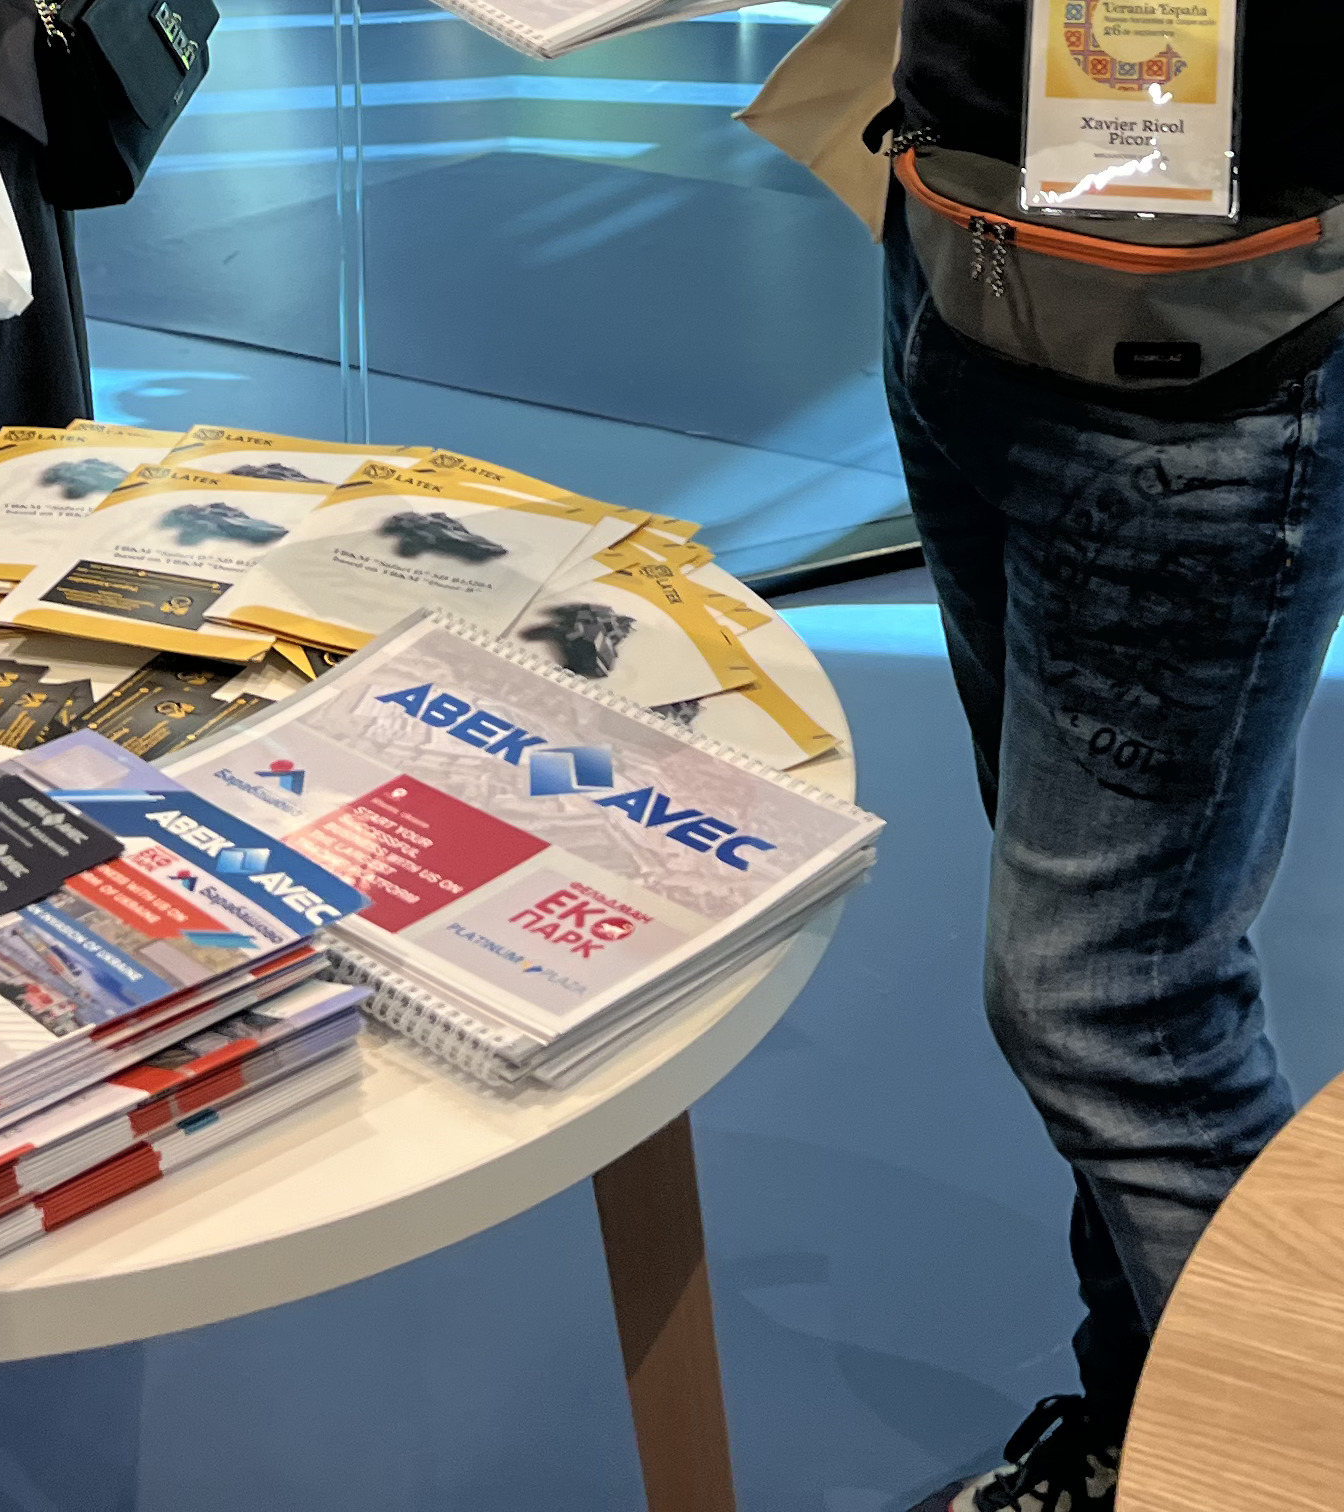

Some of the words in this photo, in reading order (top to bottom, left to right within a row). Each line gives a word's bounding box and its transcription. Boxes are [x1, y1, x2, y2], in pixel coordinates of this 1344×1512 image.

[1159, 3, 1207, 18] España
[1081, 116, 1136, 133] Xavier
[1143, 116, 1184, 134] Ricol
[225, 434, 273, 447] LATEK
[171, 472, 219, 486] LATEK
[459, 462, 505, 482] LATEK
[394, 474, 443, 493] LATEK
[353, 806, 398, 829] START
[395, 825, 433, 848] YOUR
[604, 786, 777, 871] AVEC
[419, 869, 442, 883] US
[439, 879, 464, 894] ON
[248, 871, 342, 927] AVEC
[446, 922, 524, 964] PLATINUM
[508, 908, 605, 959] ПАРК
